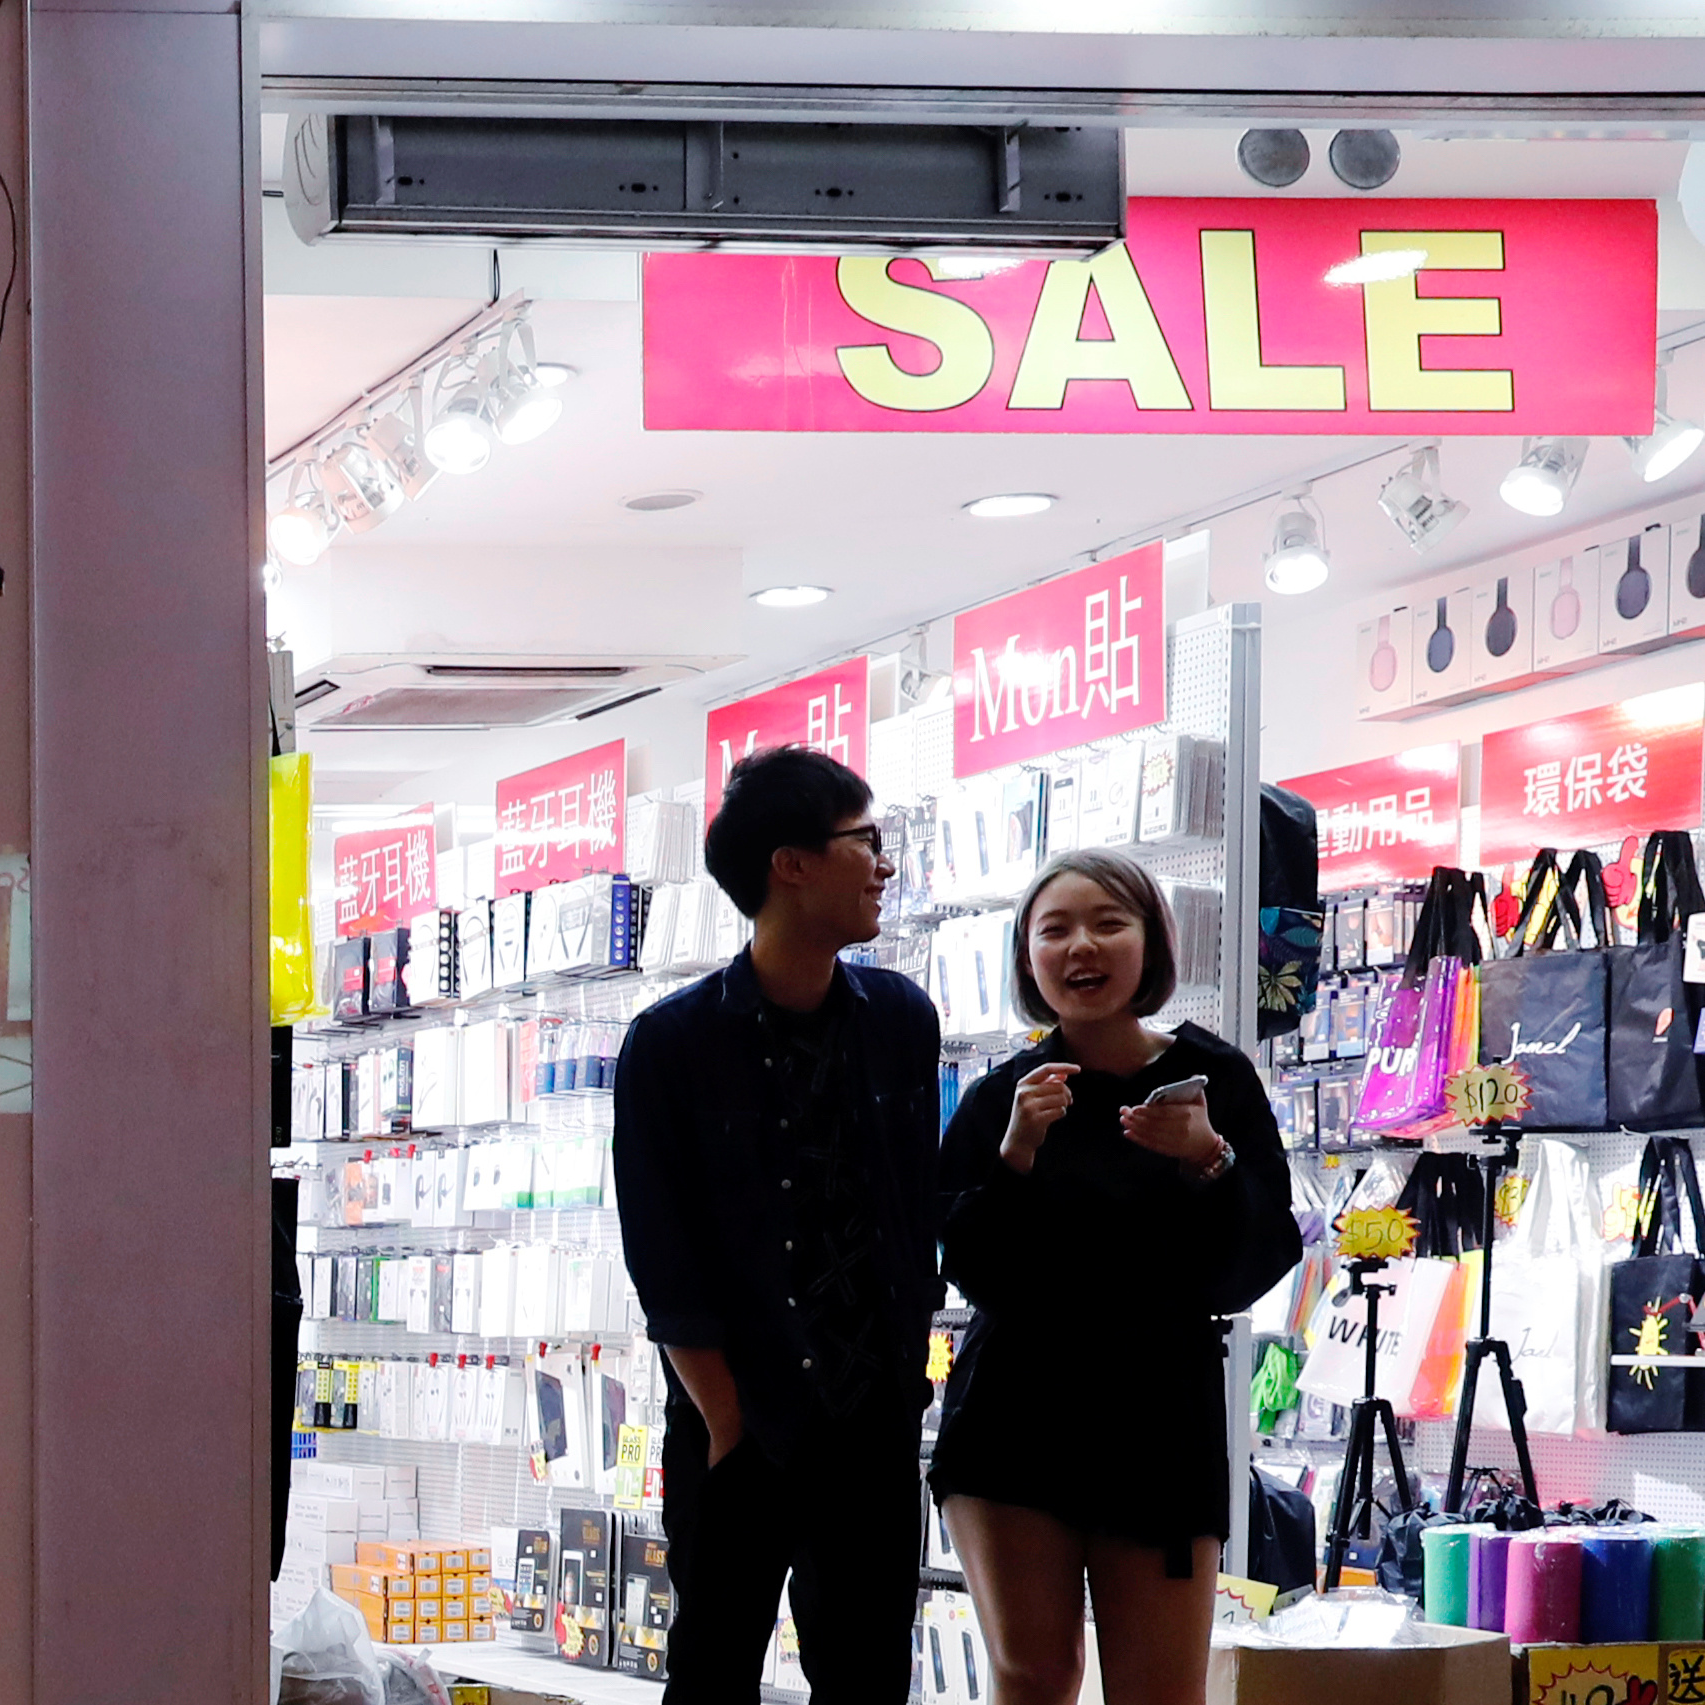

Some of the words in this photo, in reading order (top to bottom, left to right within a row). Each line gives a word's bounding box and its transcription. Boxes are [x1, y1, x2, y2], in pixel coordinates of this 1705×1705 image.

[834, 229, 1516, 414] SALE
[1522, 742, 1649, 819] 環保袋
[499, 769, 617, 878] 藍牙耳機
[338, 831, 430, 924] 藍牙耳機
[1464, 1078, 1518, 1114] $120
[1346, 1219, 1405, 1251] $50
[621, 1444, 642, 1462] PRO
[1668, 1654, 1705, 1705] 送
